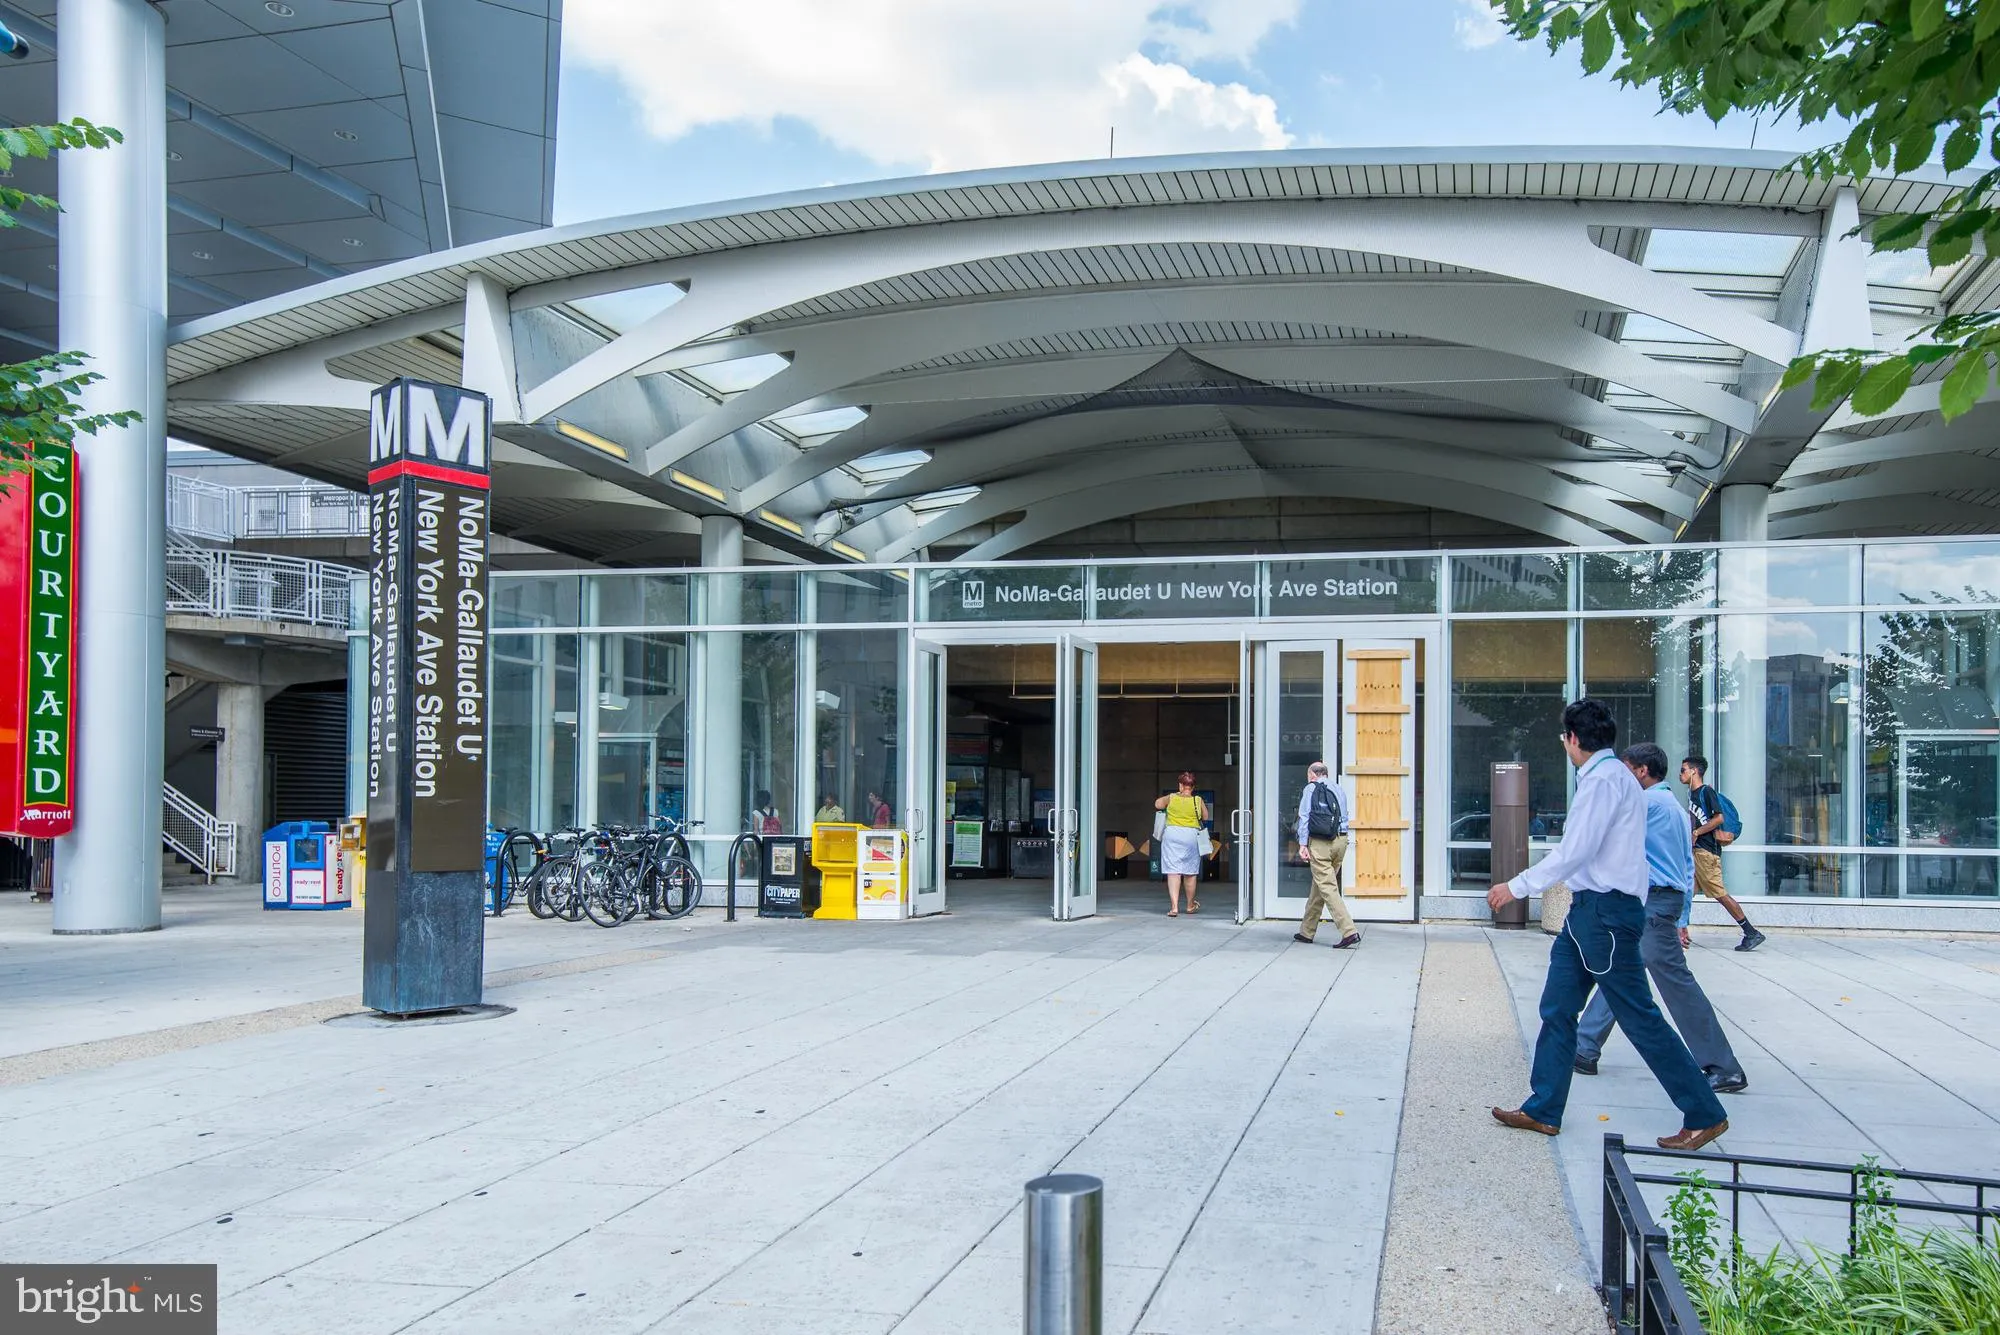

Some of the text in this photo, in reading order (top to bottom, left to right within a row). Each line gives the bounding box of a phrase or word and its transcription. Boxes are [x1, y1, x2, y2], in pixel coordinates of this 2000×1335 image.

[371, 385, 401, 462] M
[408, 384, 485, 467] M
[33, 455, 67, 794] COURTYARD
[386, 488, 400, 753] NoMa-Gallaudet U
[456, 496, 485, 754] NoMa-Gallaudet U
[964, 582, 983, 600] M
[996, 578, 1399, 603] NoMa-Galaudet U New York Ave Station
[370, 493, 384, 797] New York Ave Station
[415, 489, 445, 797] New York Ave Station
[20, 809, 71, 821] Marriott
[272, 845, 282, 898] POLITICO
[336, 866, 345, 895] ready
